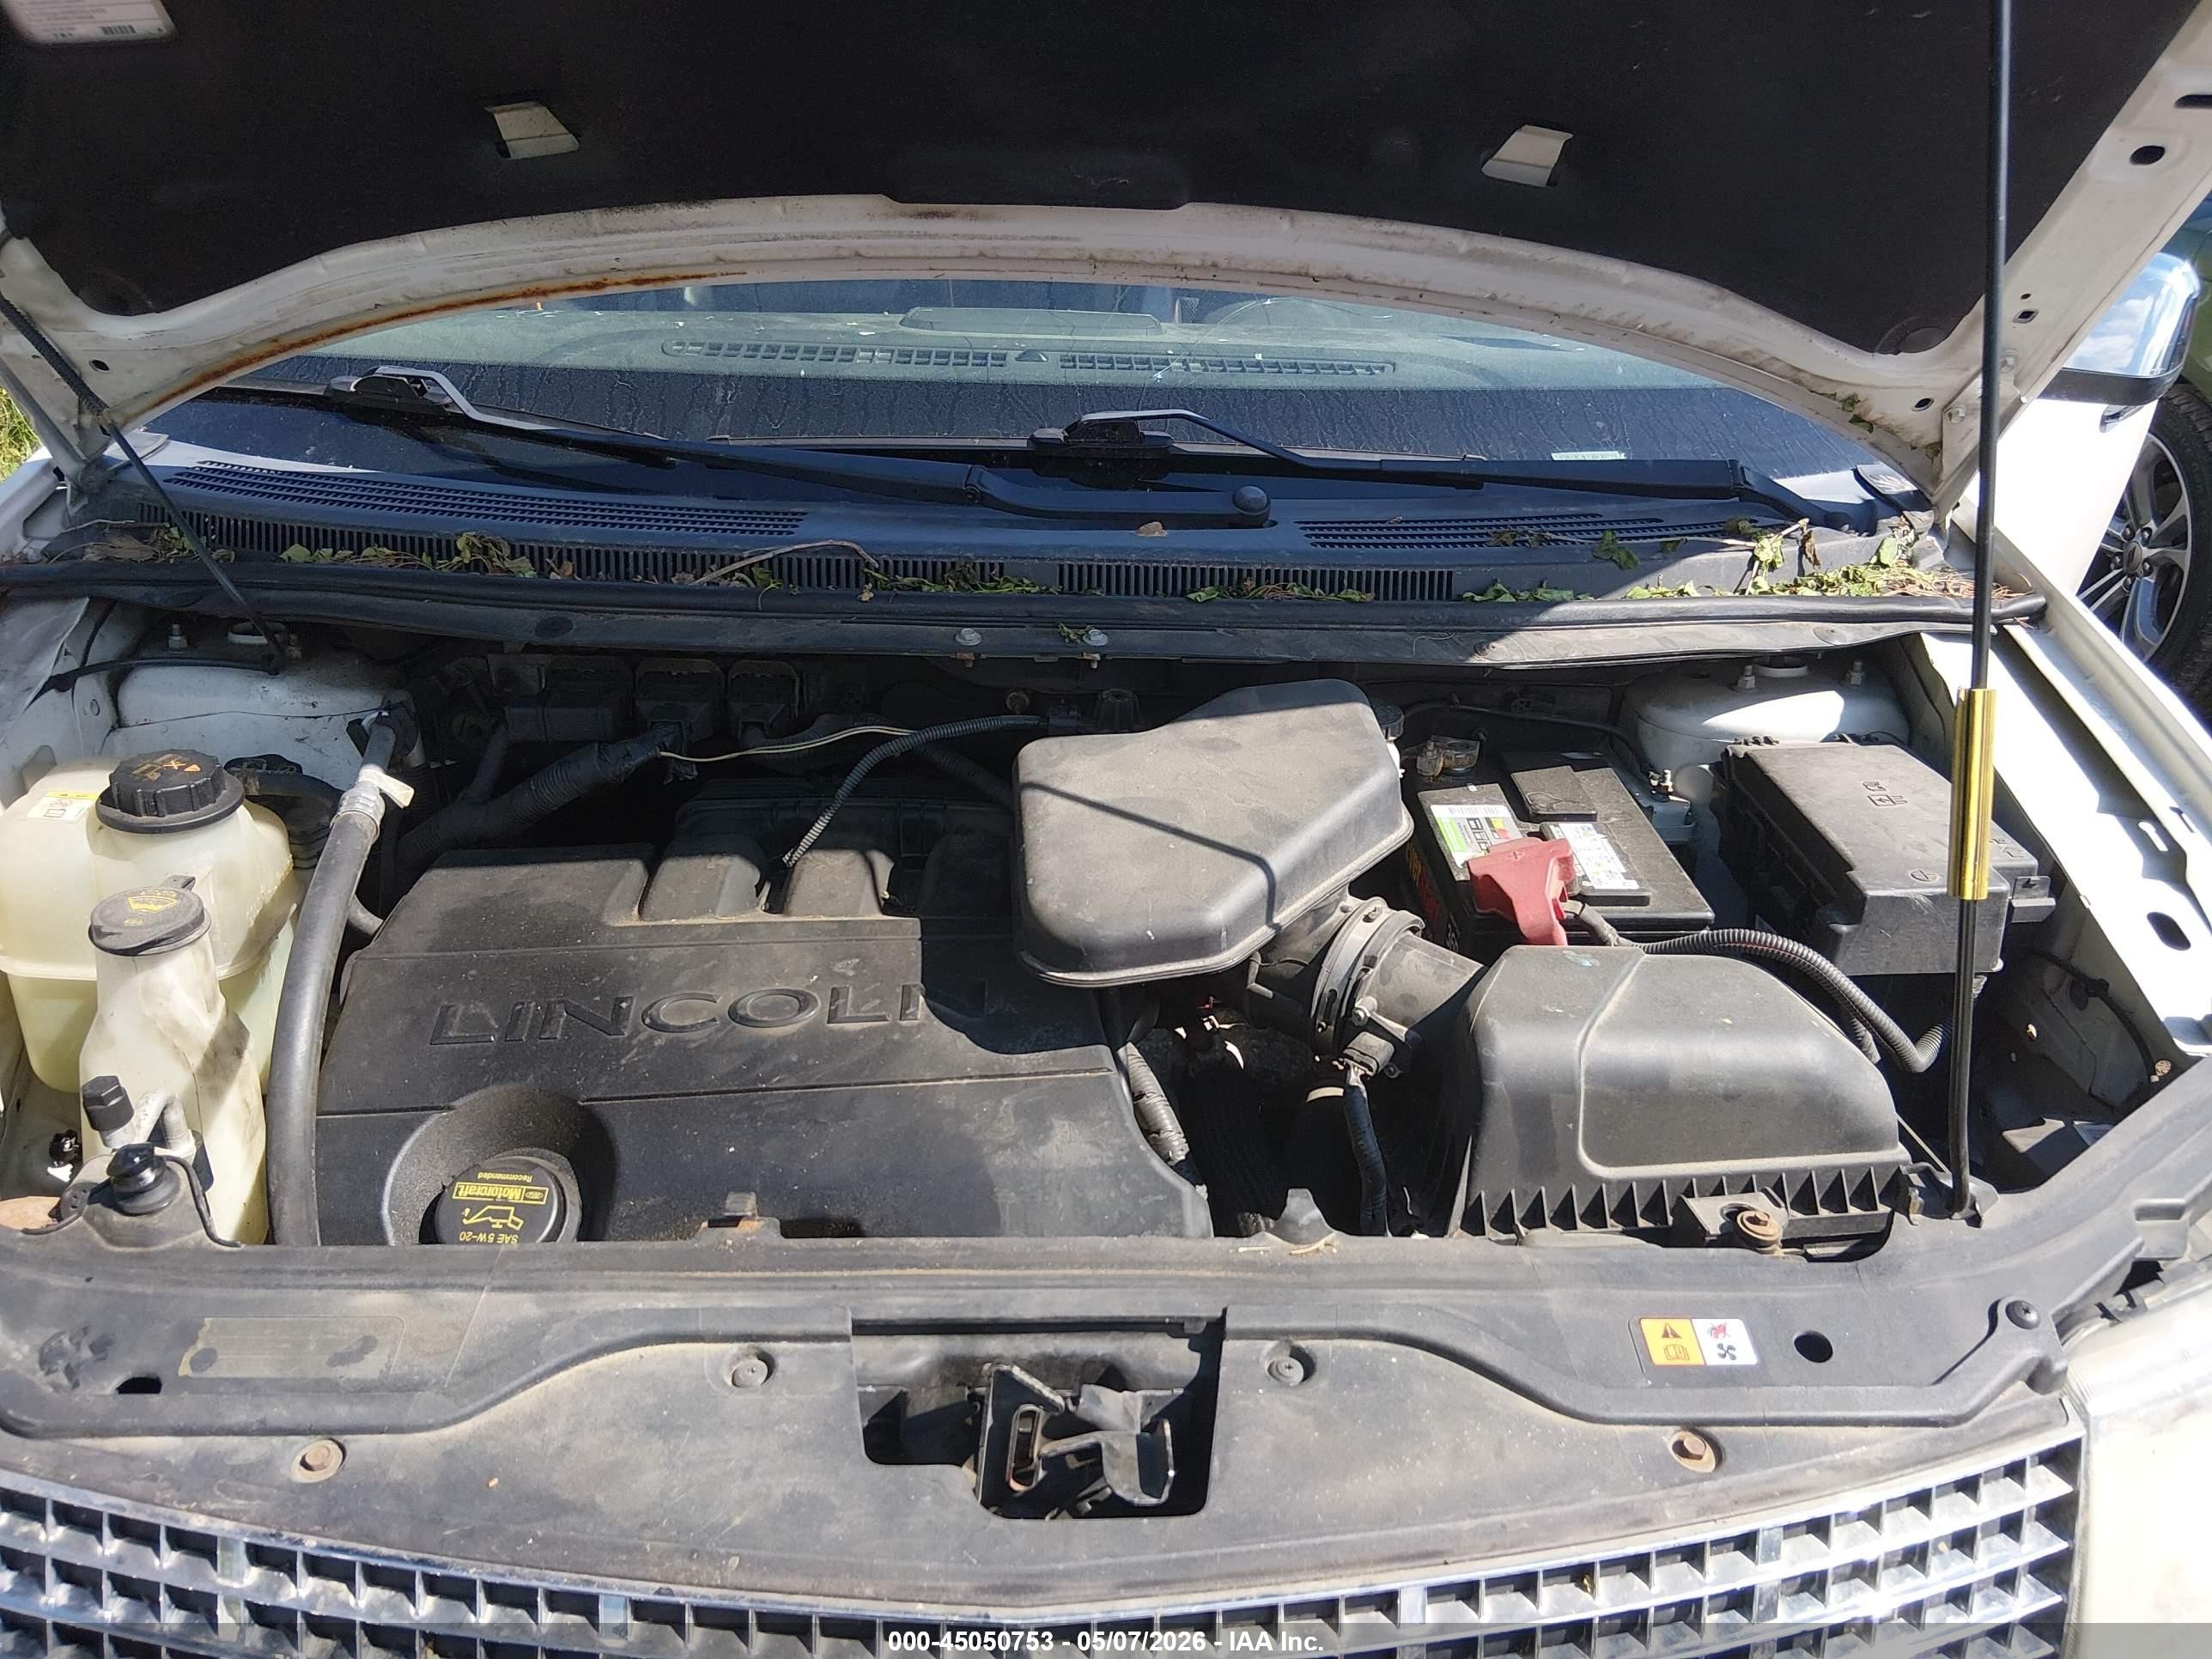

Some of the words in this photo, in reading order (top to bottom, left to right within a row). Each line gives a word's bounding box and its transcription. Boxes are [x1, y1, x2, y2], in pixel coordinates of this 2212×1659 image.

[477, 1171, 533, 1182] Recommended
[459, 1231, 495, 1243] 5W-20
[496, 1233, 519, 1244] SAE
